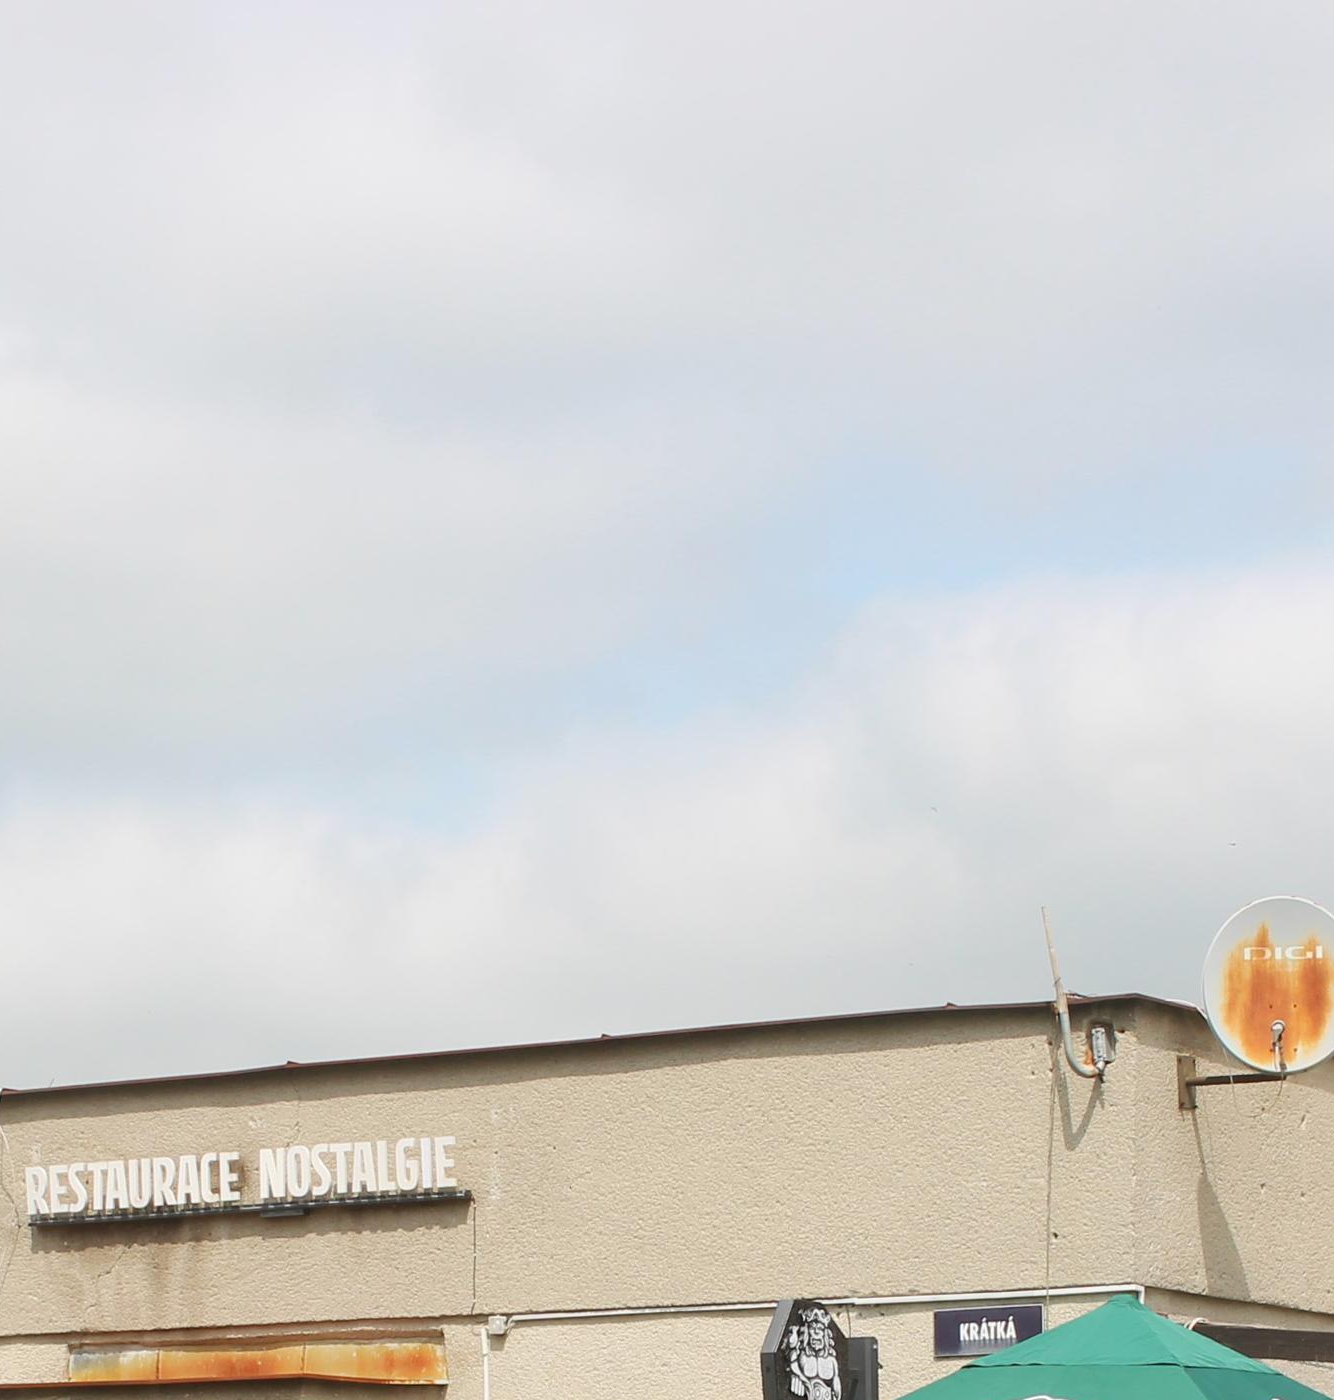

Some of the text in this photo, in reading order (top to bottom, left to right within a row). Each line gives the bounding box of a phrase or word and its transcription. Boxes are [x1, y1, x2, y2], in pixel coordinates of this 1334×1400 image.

[1243, 945, 1324, 961] DIGI
[25, 1136, 458, 1216] RESTAURACE NOSTALGIE
[958, 1315, 1017, 1342] KRÁTKÁ
